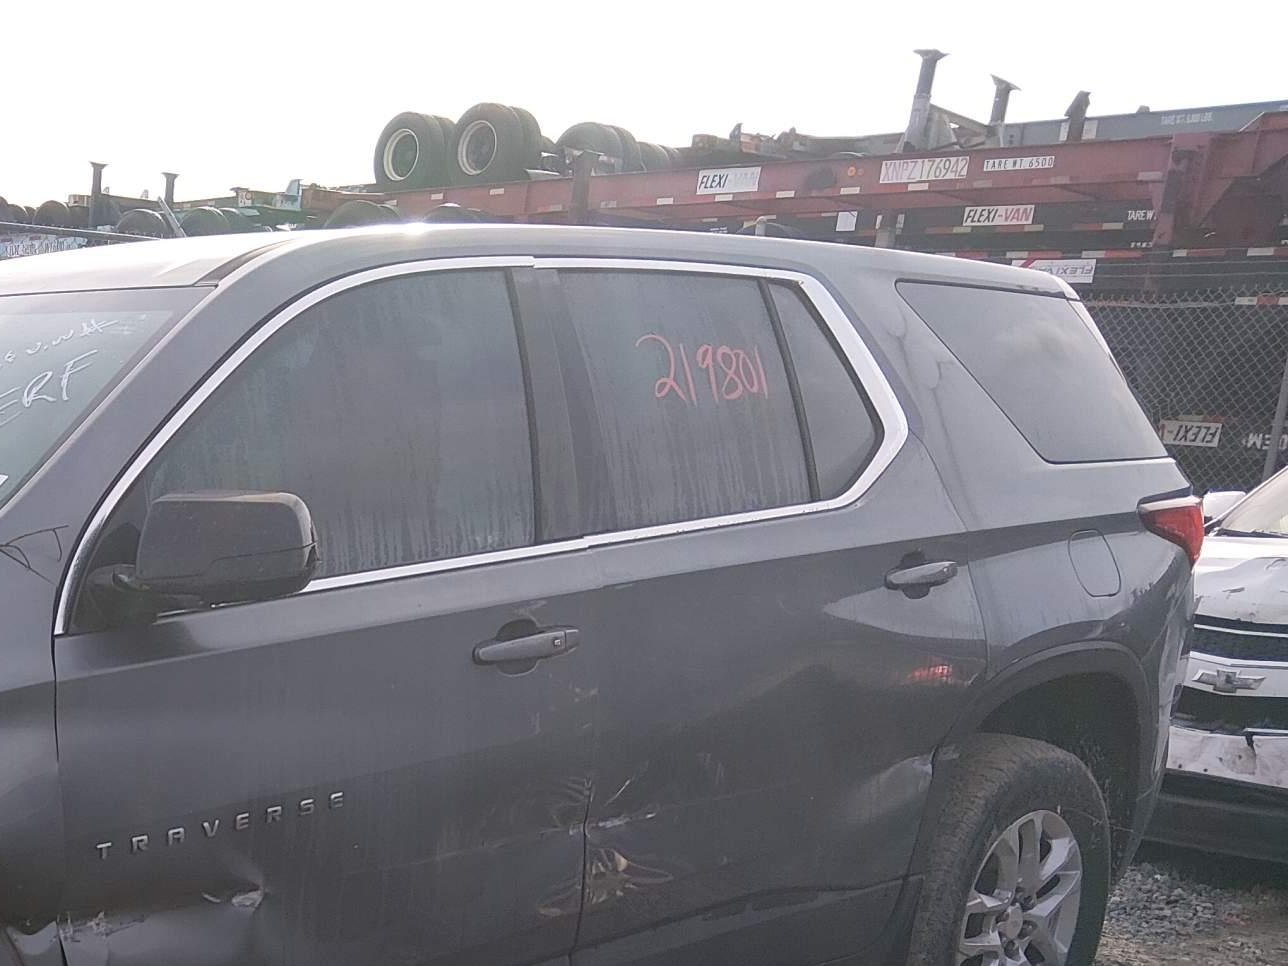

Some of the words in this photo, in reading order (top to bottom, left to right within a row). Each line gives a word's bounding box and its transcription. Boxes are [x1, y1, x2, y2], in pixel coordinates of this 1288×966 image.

[985, 160, 1008, 170] TARE
[1028, 157, 1054, 167] 6500
[964, 207, 1033, 223] FLEXI-VAN
[635, 334, 769, 407] 219801
[96, 791, 345, 861] TRAVERSE
